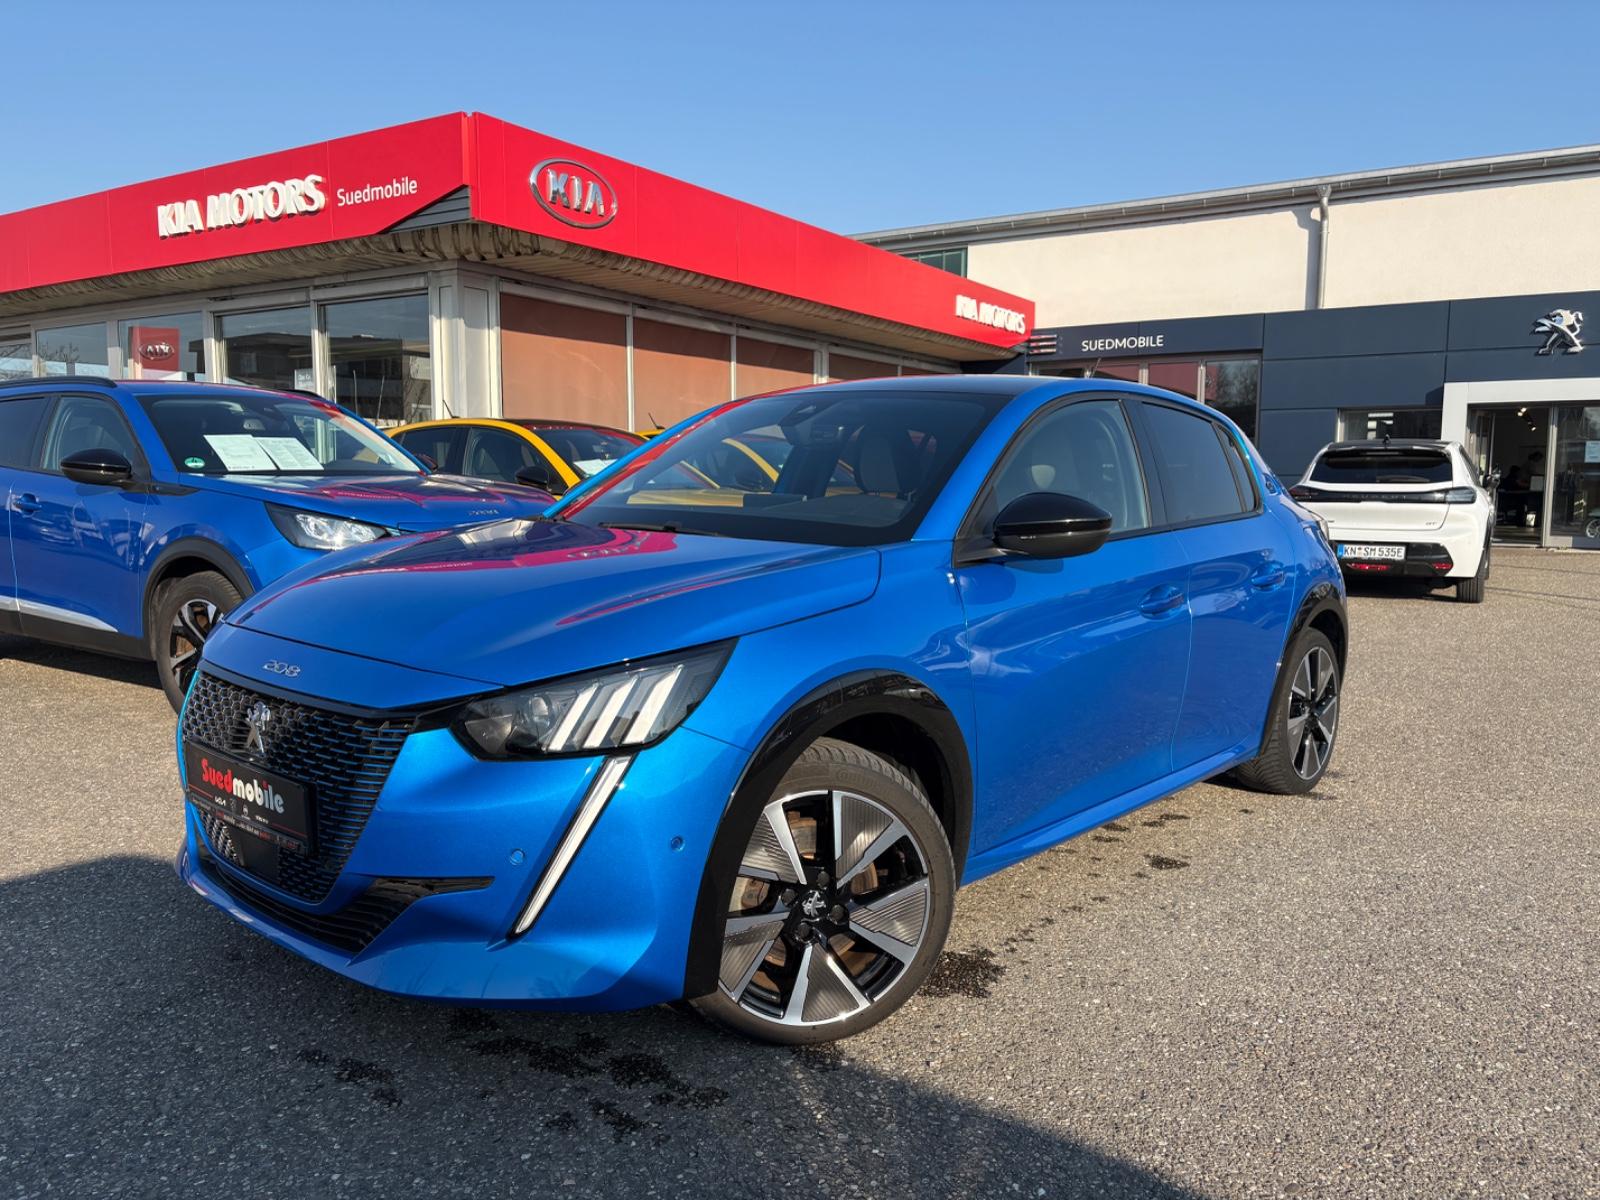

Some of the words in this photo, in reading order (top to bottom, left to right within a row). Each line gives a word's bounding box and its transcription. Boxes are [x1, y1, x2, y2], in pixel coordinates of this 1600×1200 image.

[157, 199, 204, 238] KIA
[206, 174, 326, 231] MOTORS
[336, 177, 418, 207] Suedmobile
[547, 168, 605, 217] KIA
[955, 294, 979, 322] KIA
[979, 302, 1026, 335] MOTORS
[1081, 334, 1164, 352] SUEDMOBILE
[262, 659, 301, 678] 208
[200, 758, 285, 815] Suedmobile
